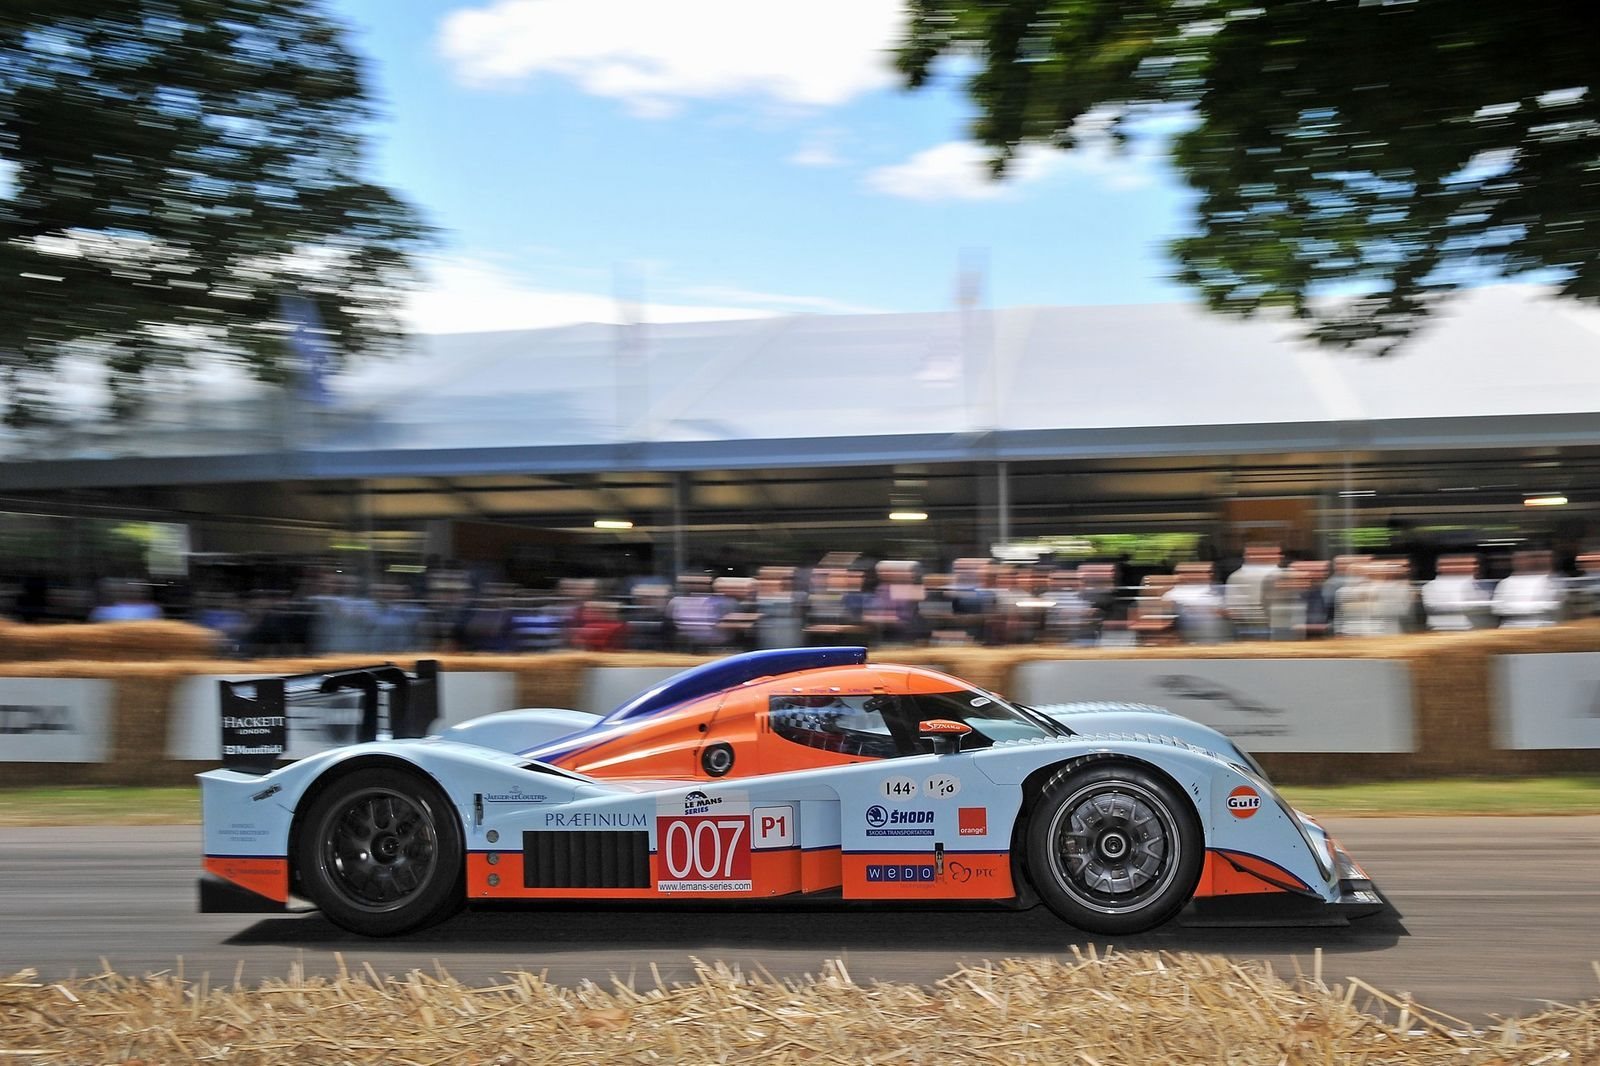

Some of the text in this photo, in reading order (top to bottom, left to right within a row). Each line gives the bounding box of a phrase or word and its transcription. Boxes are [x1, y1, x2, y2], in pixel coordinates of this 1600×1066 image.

[223, 716, 285, 728] HACKETT
[697, 797, 723, 806] MANS
[1228, 798, 1260, 807] Gulf
[684, 806, 709, 815] SERIES
[890, 809, 935, 824] ŠKODA
[545, 813, 647, 827] PRÆFINIUM
[761, 816, 786, 838] P1
[665, 820, 745, 879] 007
[659, 881, 751, 891] www.lemans-series.com
